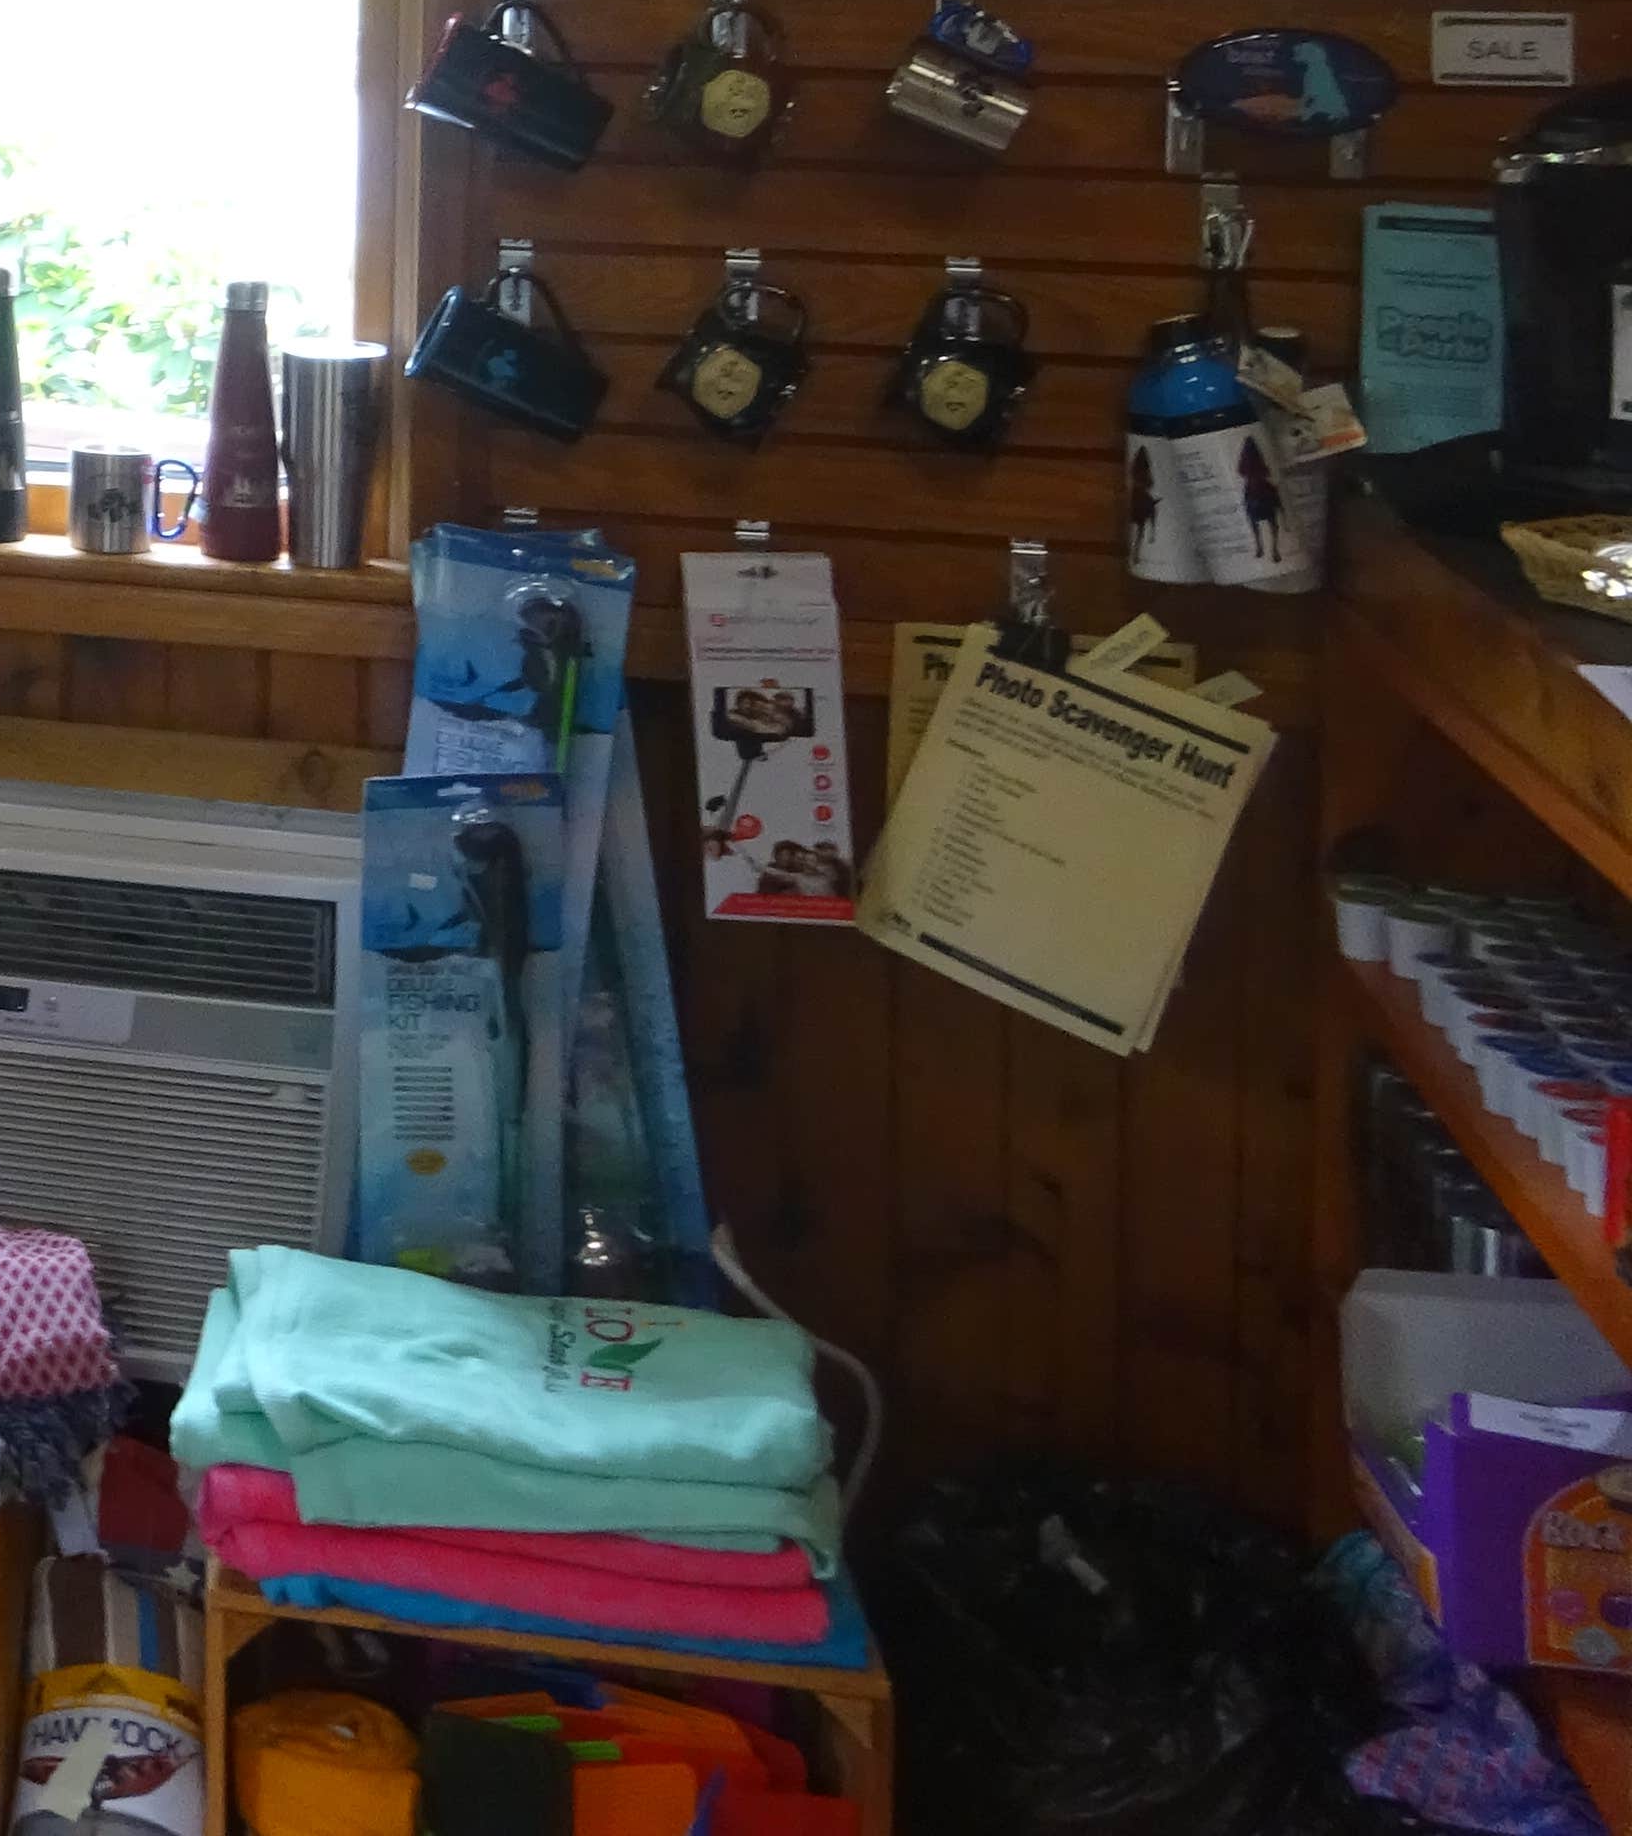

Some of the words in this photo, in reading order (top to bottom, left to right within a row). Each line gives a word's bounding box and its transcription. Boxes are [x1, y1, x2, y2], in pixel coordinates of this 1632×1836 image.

[1466, 39, 1540, 61] SALE
[976, 661, 1046, 710] Photo
[1047, 689, 1174, 764] Scavenger
[1173, 741, 1236, 790] Hunt
[387, 992, 482, 1012] FISHING
[388, 1012, 421, 1031] KIT
[32, 1716, 184, 1754] HAMOCK
